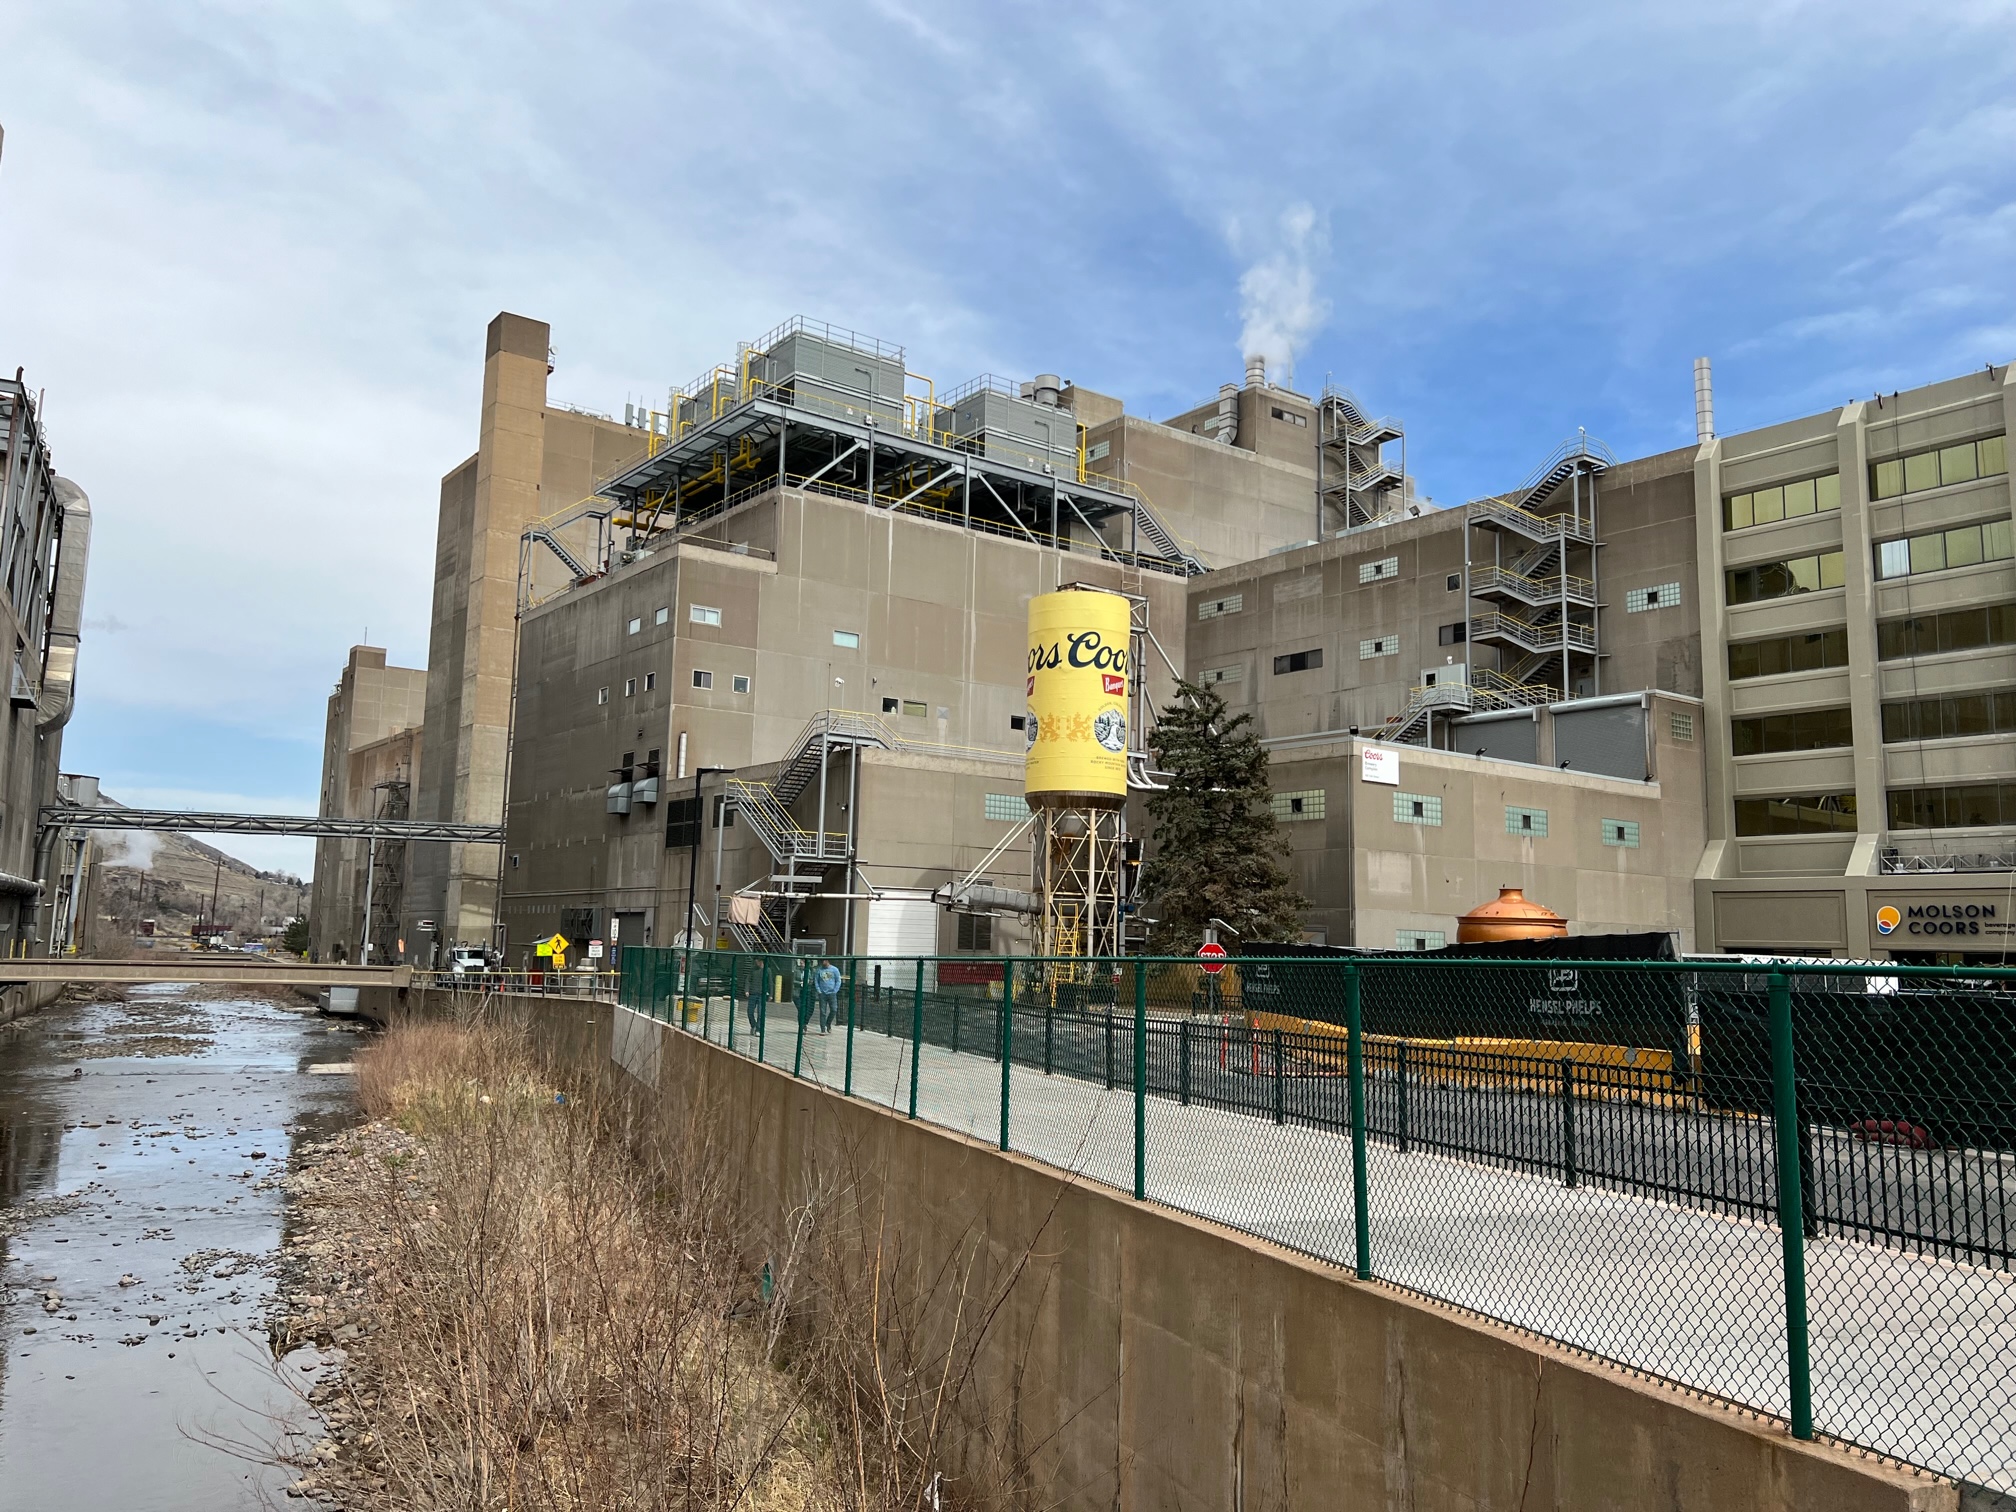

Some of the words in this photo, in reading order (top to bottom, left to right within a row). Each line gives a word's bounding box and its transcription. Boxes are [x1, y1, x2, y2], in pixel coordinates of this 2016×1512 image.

[1364, 749, 1383, 760] Coors
[1908, 905, 1995, 918] MOLSON
[1908, 922, 1979, 935] COORS
[1530, 999, 1564, 1014] HENSEL
[1566, 1000, 1602, 1015] PHELPS
